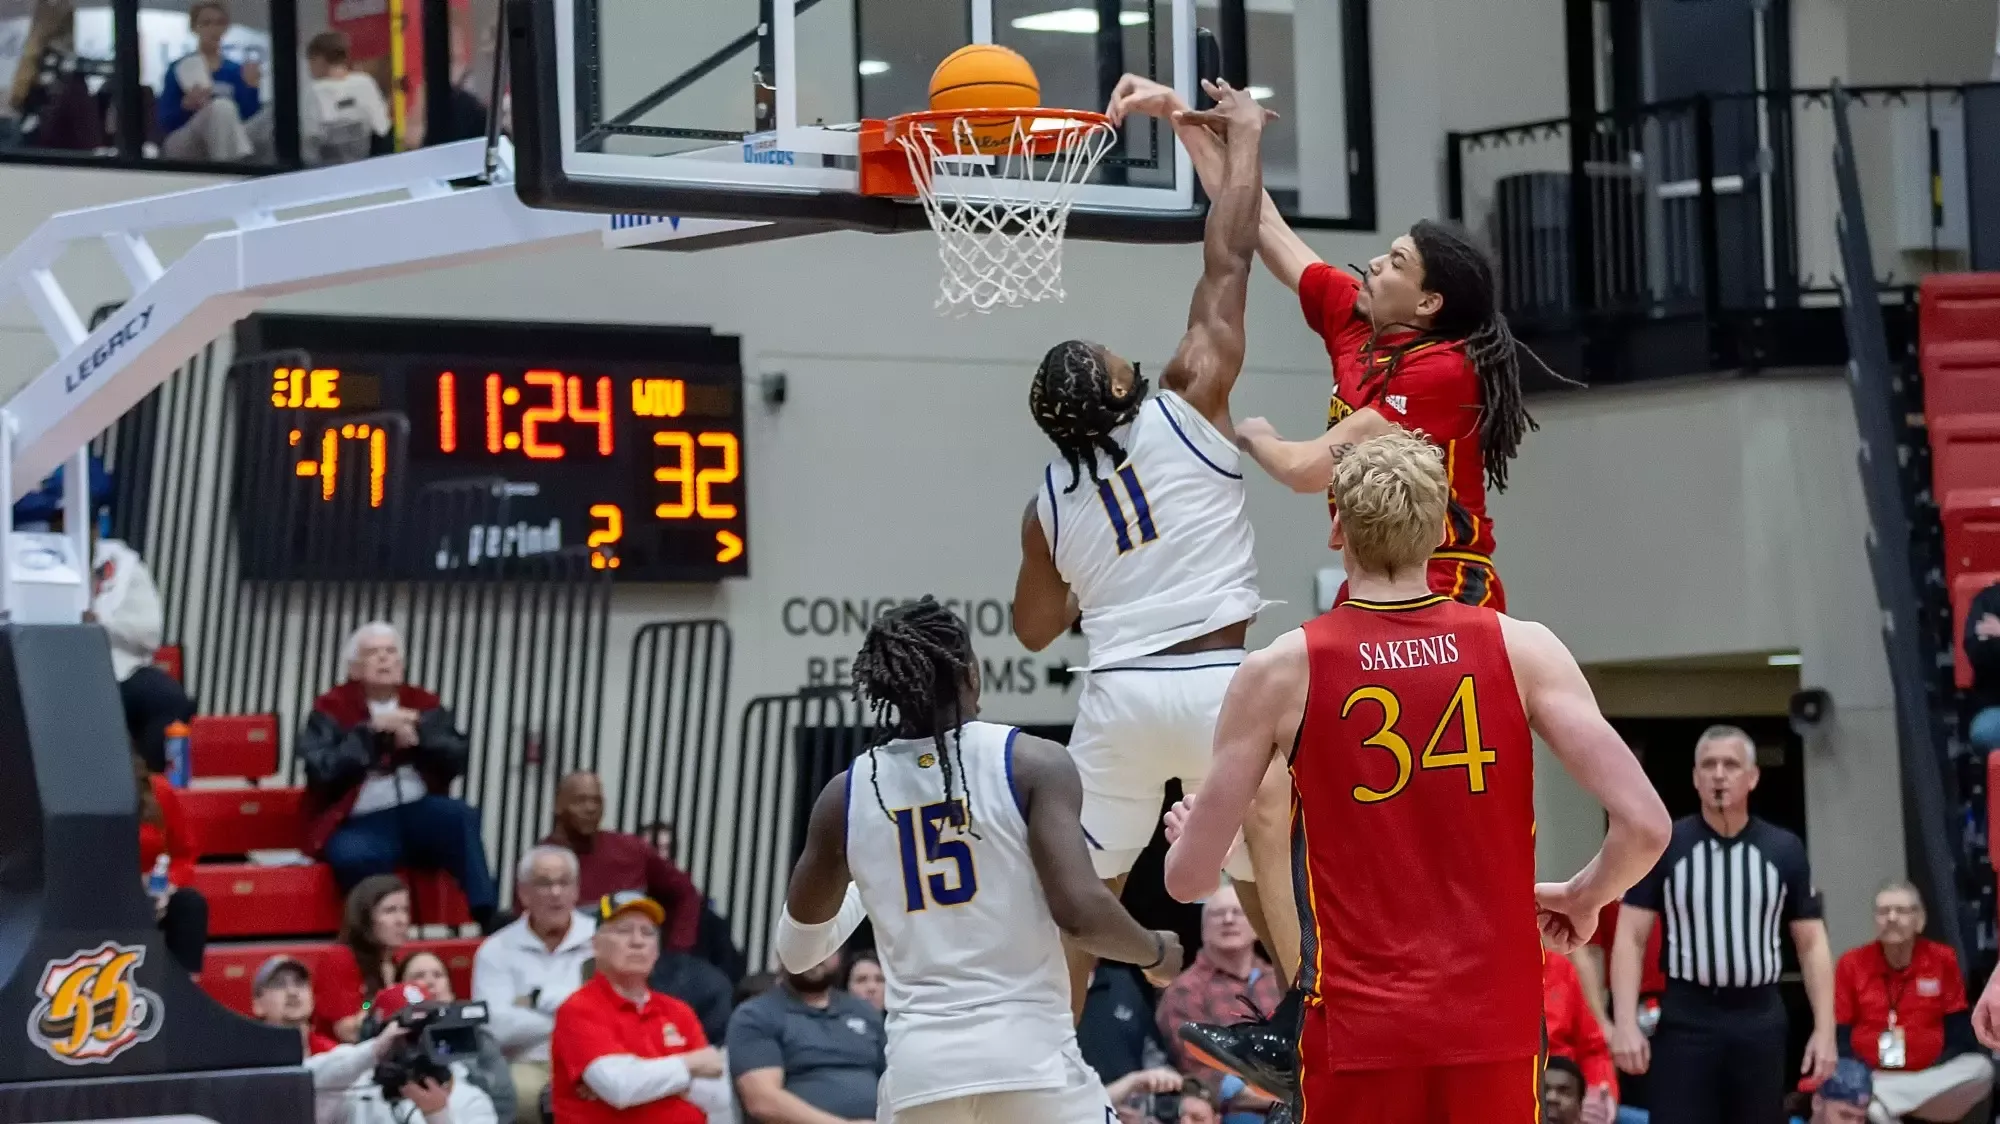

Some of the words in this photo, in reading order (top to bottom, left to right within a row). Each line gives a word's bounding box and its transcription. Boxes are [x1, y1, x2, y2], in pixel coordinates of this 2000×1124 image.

[65, 303, 156, 394] LEGACY
[438, 371, 614, 459] 11:24
[653, 431, 739, 519] 32
[1097, 464, 1160, 557] 11
[1358, 632, 1460, 672] SAKENIS
[1338, 673, 1498, 805] 34
[888, 796, 979, 914] 15
